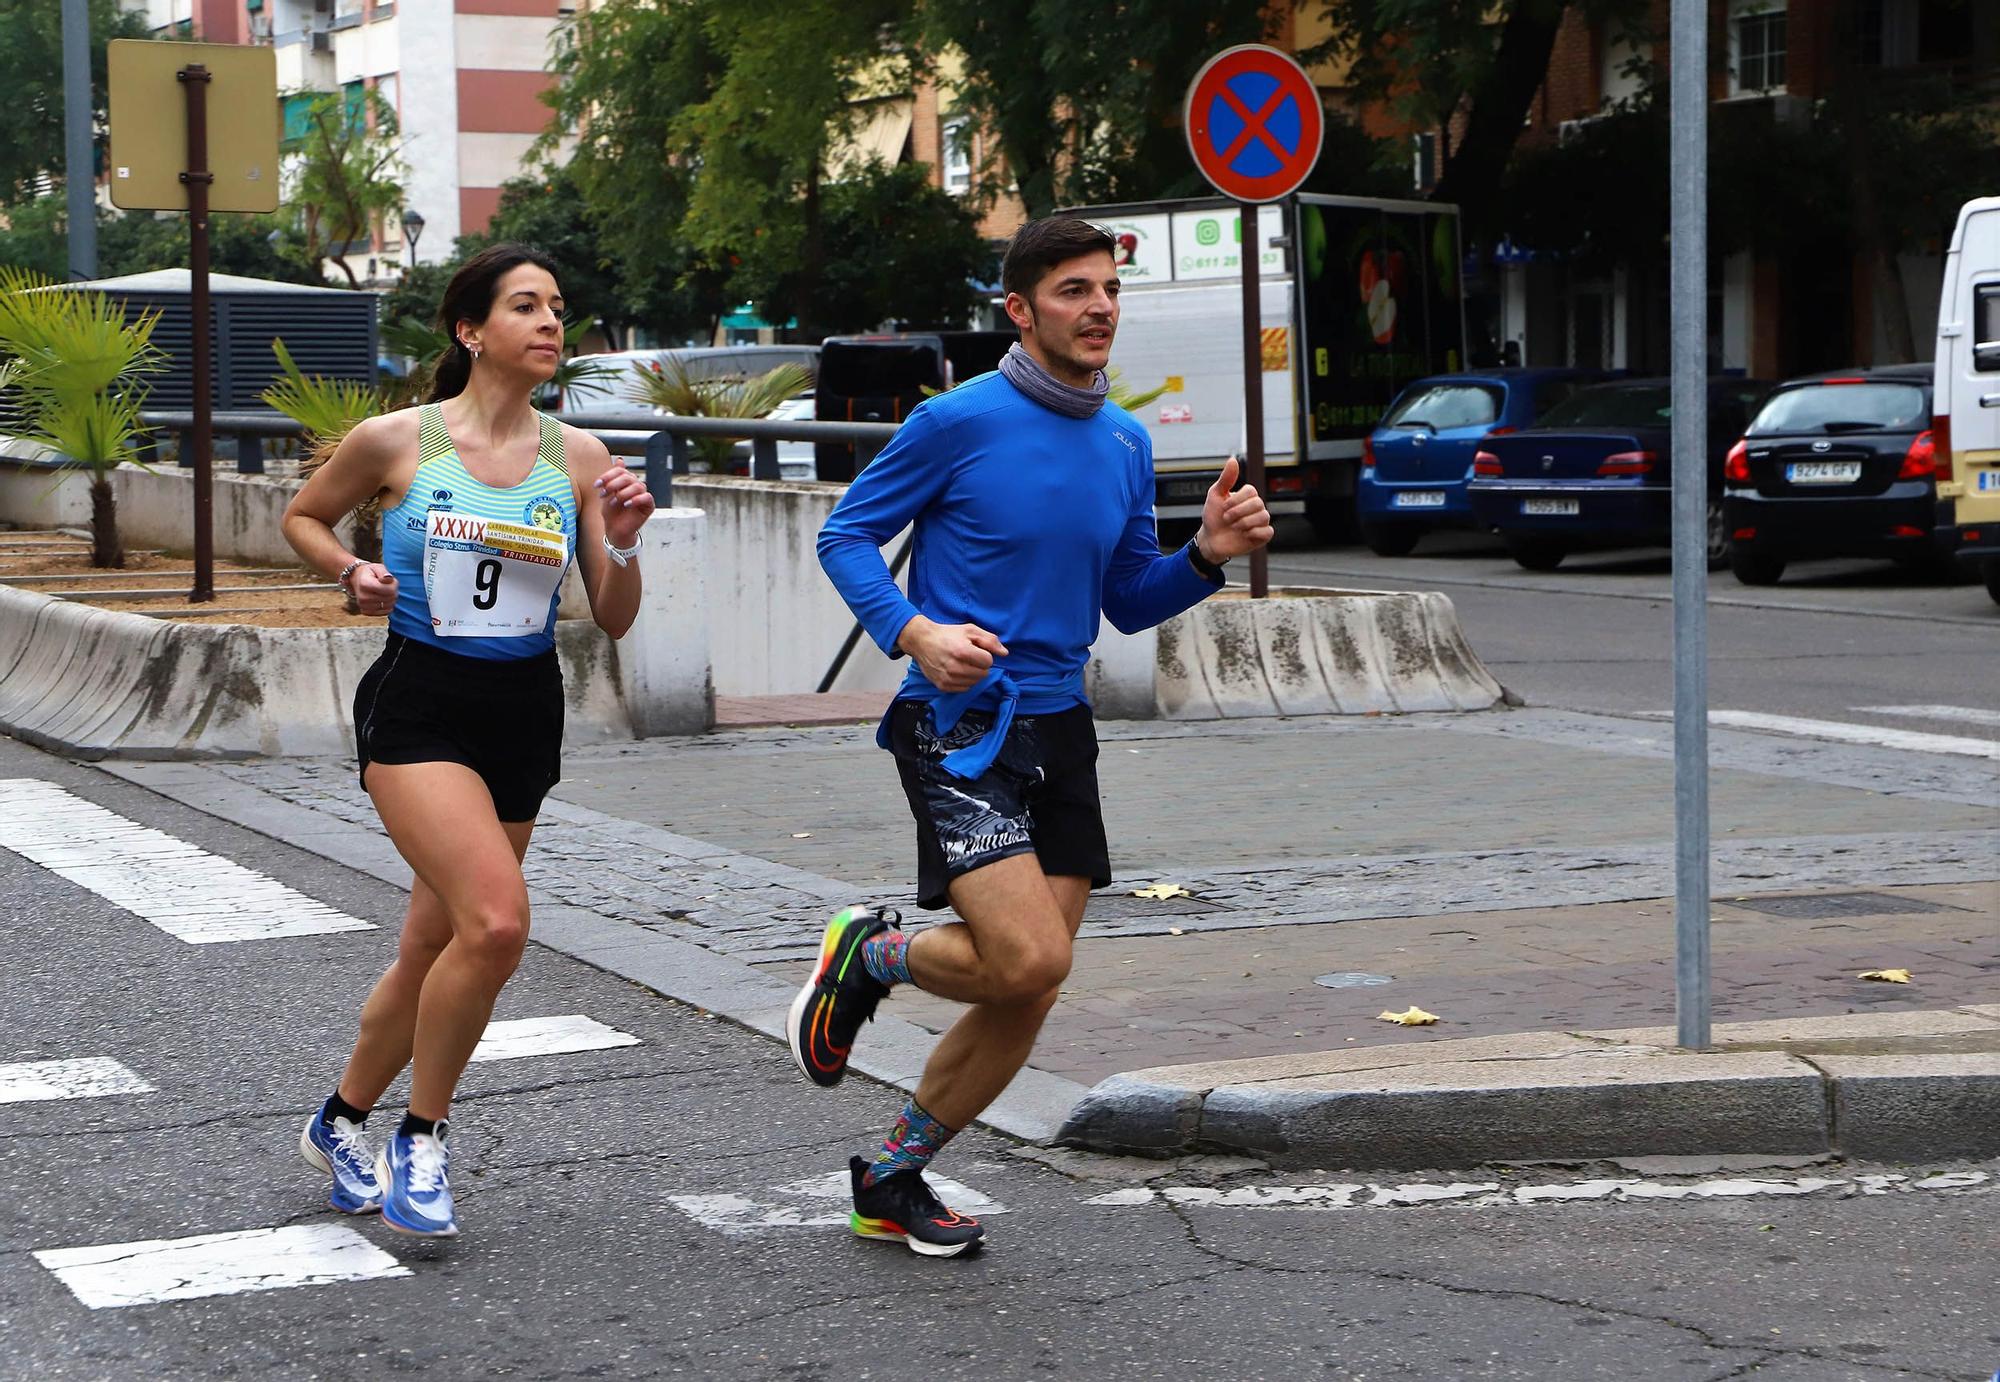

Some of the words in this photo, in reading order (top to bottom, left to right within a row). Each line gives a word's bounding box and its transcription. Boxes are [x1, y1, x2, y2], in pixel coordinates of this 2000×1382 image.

[1196, 256, 1218, 269] 611
[1223, 255, 1238, 267] 28
[1796, 463, 1830, 478] 9274
[1832, 462, 1859, 476] GFV
[433, 516, 486, 541] XXXIX
[430, 540, 453, 550] Colegio
[472, 545, 498, 555] Trinidad
[518, 536, 545, 546] TRINIDAD
[503, 551, 561, 567] TRINITARIOS
[472, 559, 503, 611] 9
